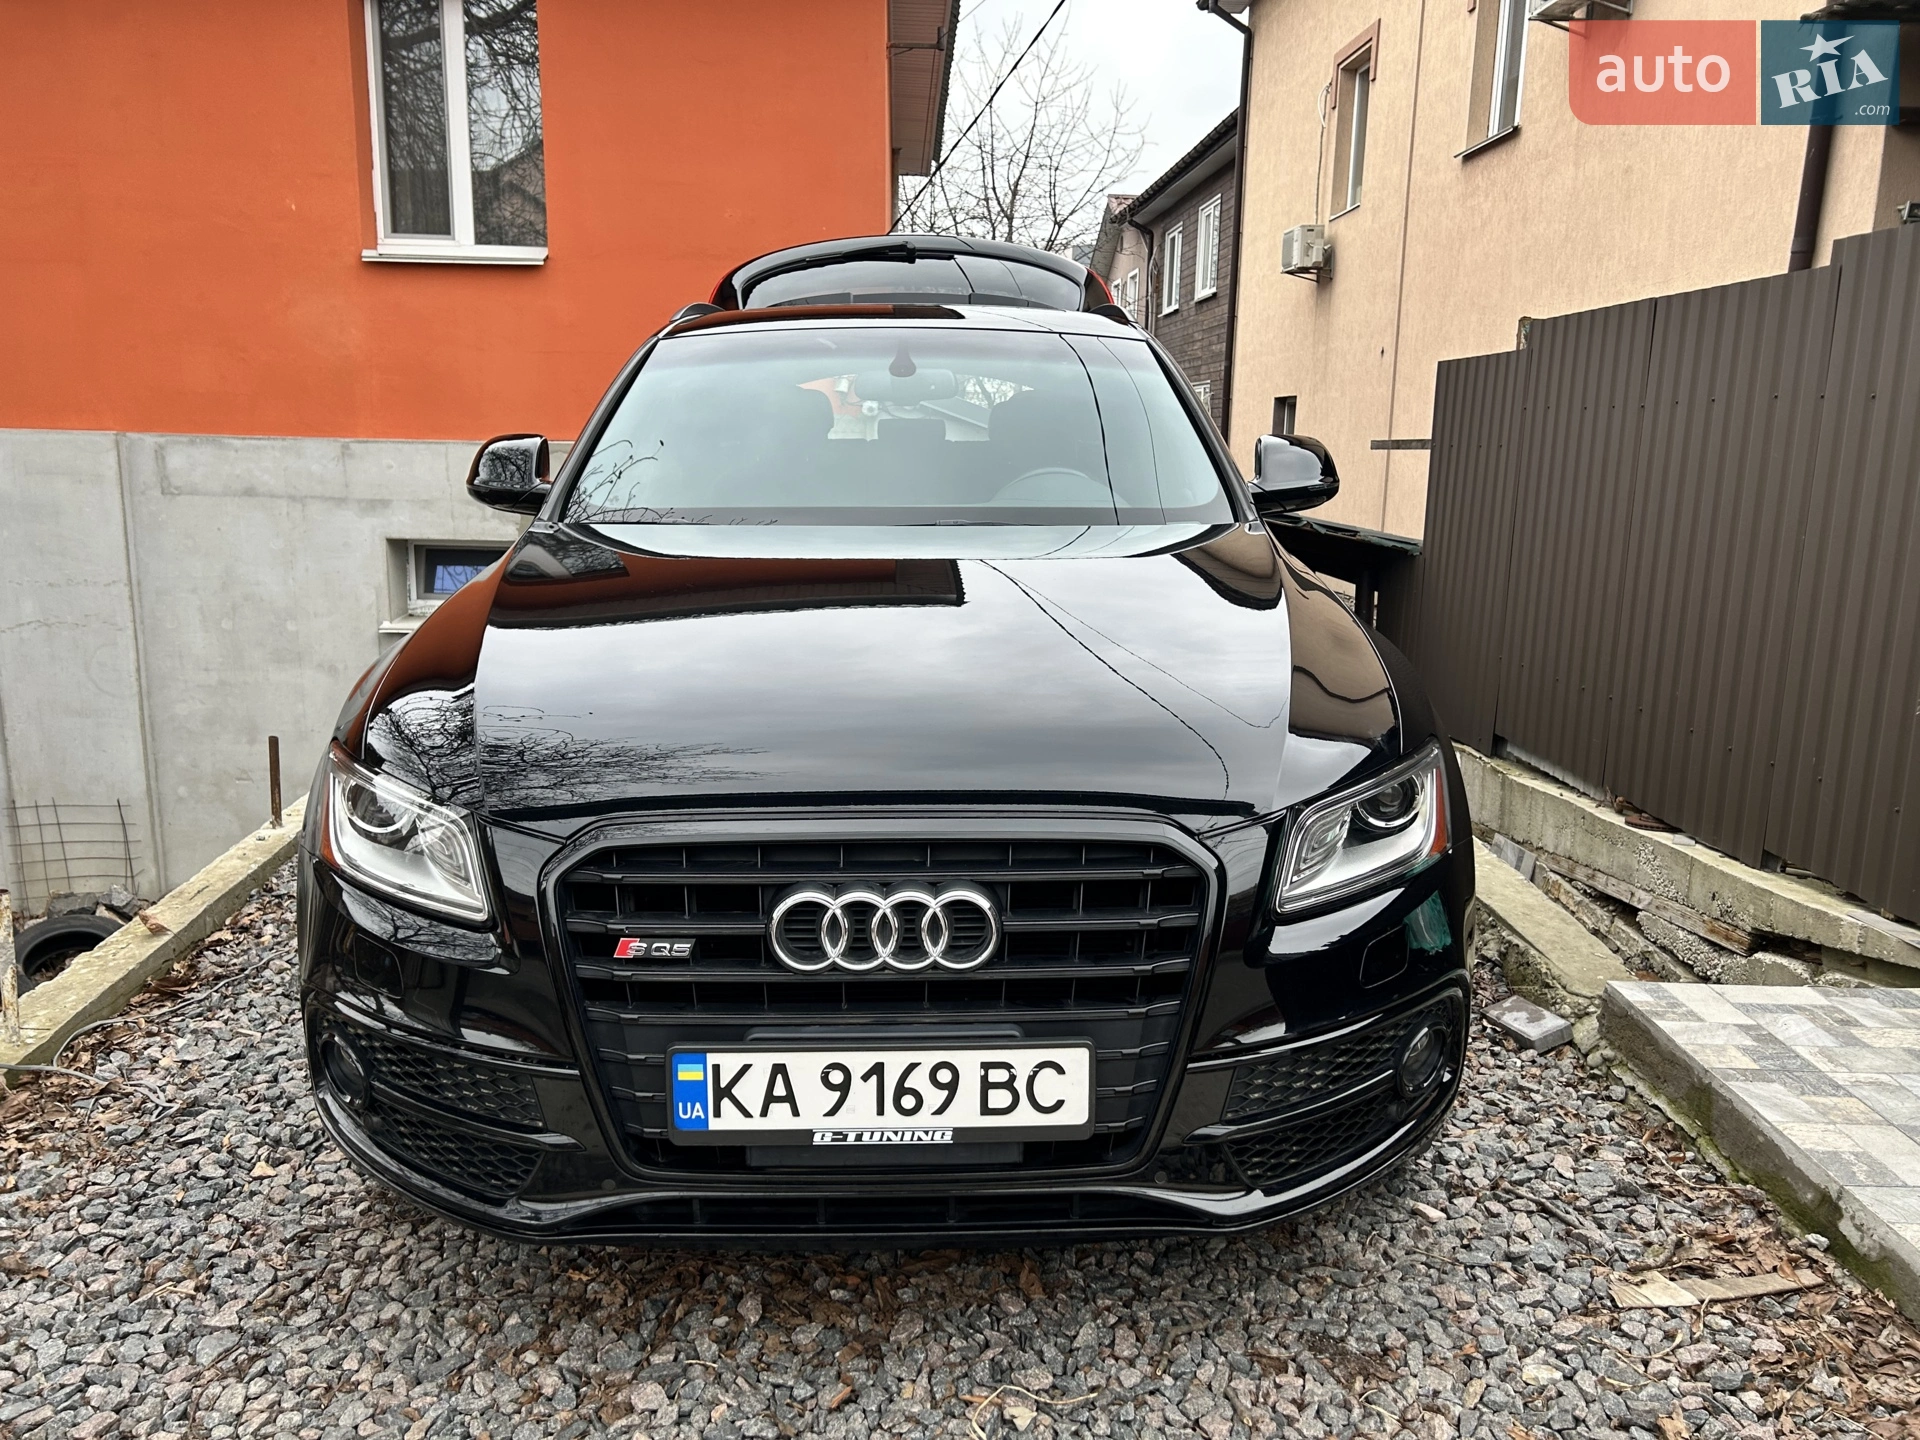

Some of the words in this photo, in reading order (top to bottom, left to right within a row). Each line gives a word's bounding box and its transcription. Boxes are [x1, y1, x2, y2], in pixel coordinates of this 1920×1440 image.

[711, 1062, 801, 1119] KA
[819, 1061, 960, 1117] 9169
[979, 1060, 1067, 1117] BC
[678, 1101, 705, 1119] UA
[812, 1130, 954, 1143] G-TUNING
